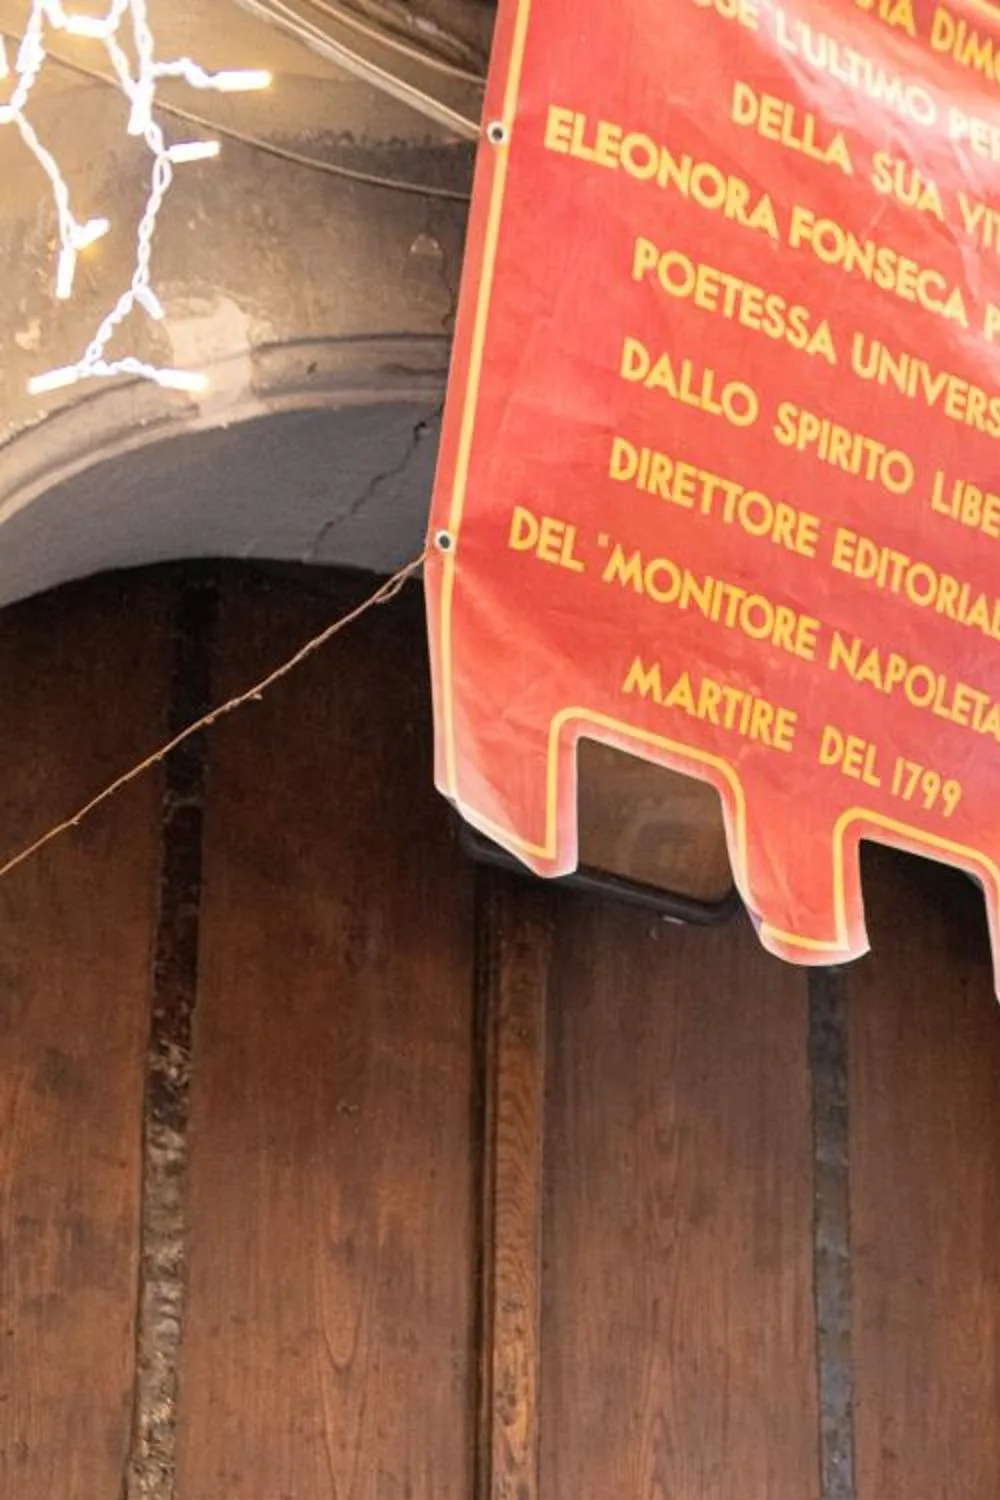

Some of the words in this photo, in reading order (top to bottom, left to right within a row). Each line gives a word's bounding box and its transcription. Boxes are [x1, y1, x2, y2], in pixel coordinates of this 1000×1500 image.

[775, 8, 937, 126] L'ULTIMO
[545, 105, 780, 241] ELEONORA
[789, 206, 968, 328] FONSECA
[732, 80, 852, 174] DELLA
[873, 151, 945, 222] SUA
[632, 236, 836, 365] POETESSA
[620, 336, 759, 427] DALLO
[773, 402, 915, 495] SPIRITO
[508, 505, 584, 573] DEL
[609, 436, 821, 558] DIRETTORE
[621, 655, 798, 753] MARTIRE
[818, 725, 881, 788] DEL
[891, 756, 961, 817] 1799
